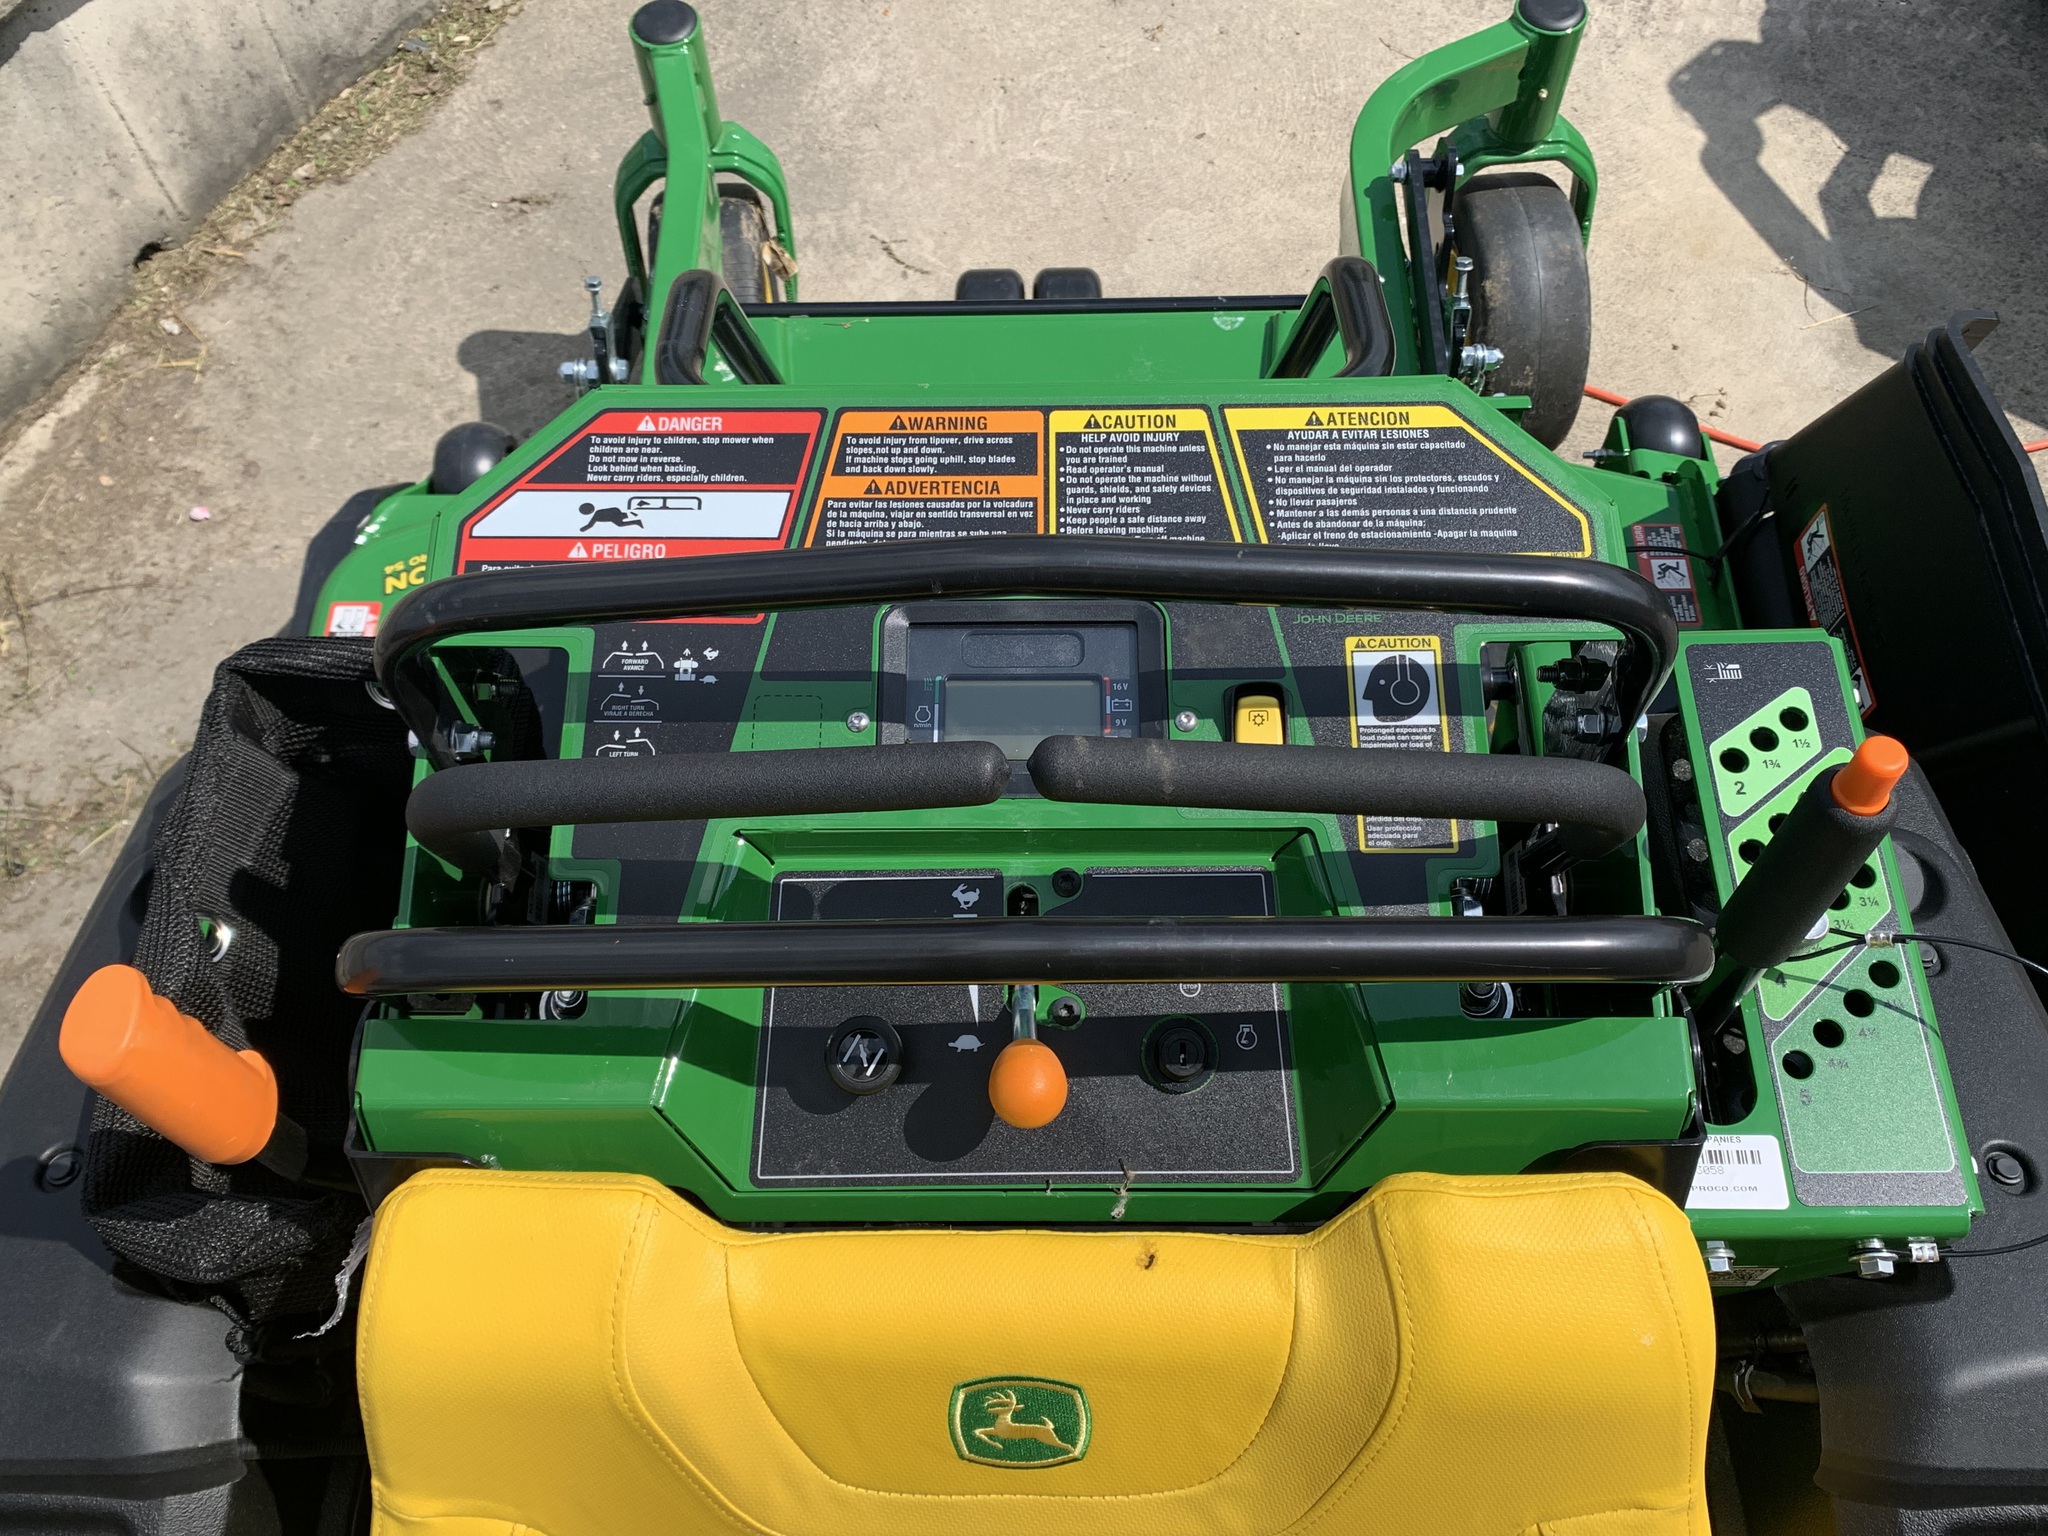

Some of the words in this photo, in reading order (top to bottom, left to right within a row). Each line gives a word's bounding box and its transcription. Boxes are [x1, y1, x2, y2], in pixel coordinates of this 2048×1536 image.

[658, 417, 723, 431] DANGER
[908, 416, 987, 430] WARNING
[1102, 414, 1175, 429] CAUTION
[1326, 412, 1409, 426] ATENCION
[1081, 434, 1106, 442] HELP
[1109, 433, 1140, 442] AVOID
[1143, 433, 1179, 442] INJURY
[1287, 431, 1328, 440] AYUDAR
[1332, 431, 1338, 439] A
[1341, 430, 1377, 439] EVITAR
[1380, 430, 1429, 439] LESIONES
[591, 436, 600, 444] To
[602, 436, 625, 444] avoid
[627, 436, 651, 446] injury
[653, 436, 661, 444] to
[663, 436, 699, 446] children,
[702, 436, 719, 446] stop
[751, 436, 773, 444] when
[846, 436, 856, 444] To
[858, 436, 880, 444] avoid
[883, 436, 906, 446] injury
[908, 436, 927, 444] from
[929, 436, 960, 446] tipover,
[963, 436, 983, 444] drive
[589, 445, 623, 453] children
[903, 446, 918, 454] and
[920, 446, 944, 454] down.
[1093, 445, 1124, 455] operate
[1125, 445, 1140, 453] this
[1273, 443, 1284, 451] No
[1287, 443, 1321, 452] manejar
[1323, 442, 1341, 450] esta
[1343, 442, 1379, 452] máquina
[1396, 441, 1417, 449] estar
[1420, 441, 1465, 450] capacitado
[639, 455, 647, 463] in
[890, 456, 912, 465] stops
[914, 455, 937, 465] going
[939, 455, 966, 465] uphill,
[968, 455, 986, 465] stop
[988, 455, 1015, 463] blades
[1065, 457, 1080, 465] you
[1098, 455, 1127, 463] trained
[1274, 455, 1292, 463] para
[587, 464, 607, 472] Look
[609, 464, 638, 472] behind
[640, 464, 662, 472] when
[664, 464, 698, 474] backing.
[845, 465, 860, 473] and
[862, 465, 882, 473] back
[884, 465, 905, 473] down
[908, 465, 937, 474] slowly.
[1089, 465, 1131, 475] operator's
[1305, 464, 1336, 472] manual
[1339, 464, 1352, 472] del
[1354, 464, 1392, 473] operador
[613, 475, 634, 483] carry
[636, 474, 663, 484] riders,
[666, 474, 708, 484] especially
[710, 474, 746, 482] children.
[884, 480, 1000, 495] ADVERTENCIA
[889, 500, 924, 508] lesiones
[926, 500, 964, 508] causadas
[967, 502, 980, 510] por
[983, 500, 990, 508] la
[993, 500, 1033, 508] volcadura
[1316, 497, 1357, 507] pasajeros
[1066, 506, 1090, 514] Never
[1066, 516, 1087, 526] Keep
[1089, 516, 1117, 525] people
[1095, 526, 1126, 536] leaving
[1128, 526, 1166, 534] machine:
[592, 544, 665, 559] PELIGRO
[1293, 614, 1331, 624] JOHN
[1335, 613, 1381, 623] DEERE
[1367, 638, 1430, 648] CAUTION
[1734, 782, 1746, 796] 2
